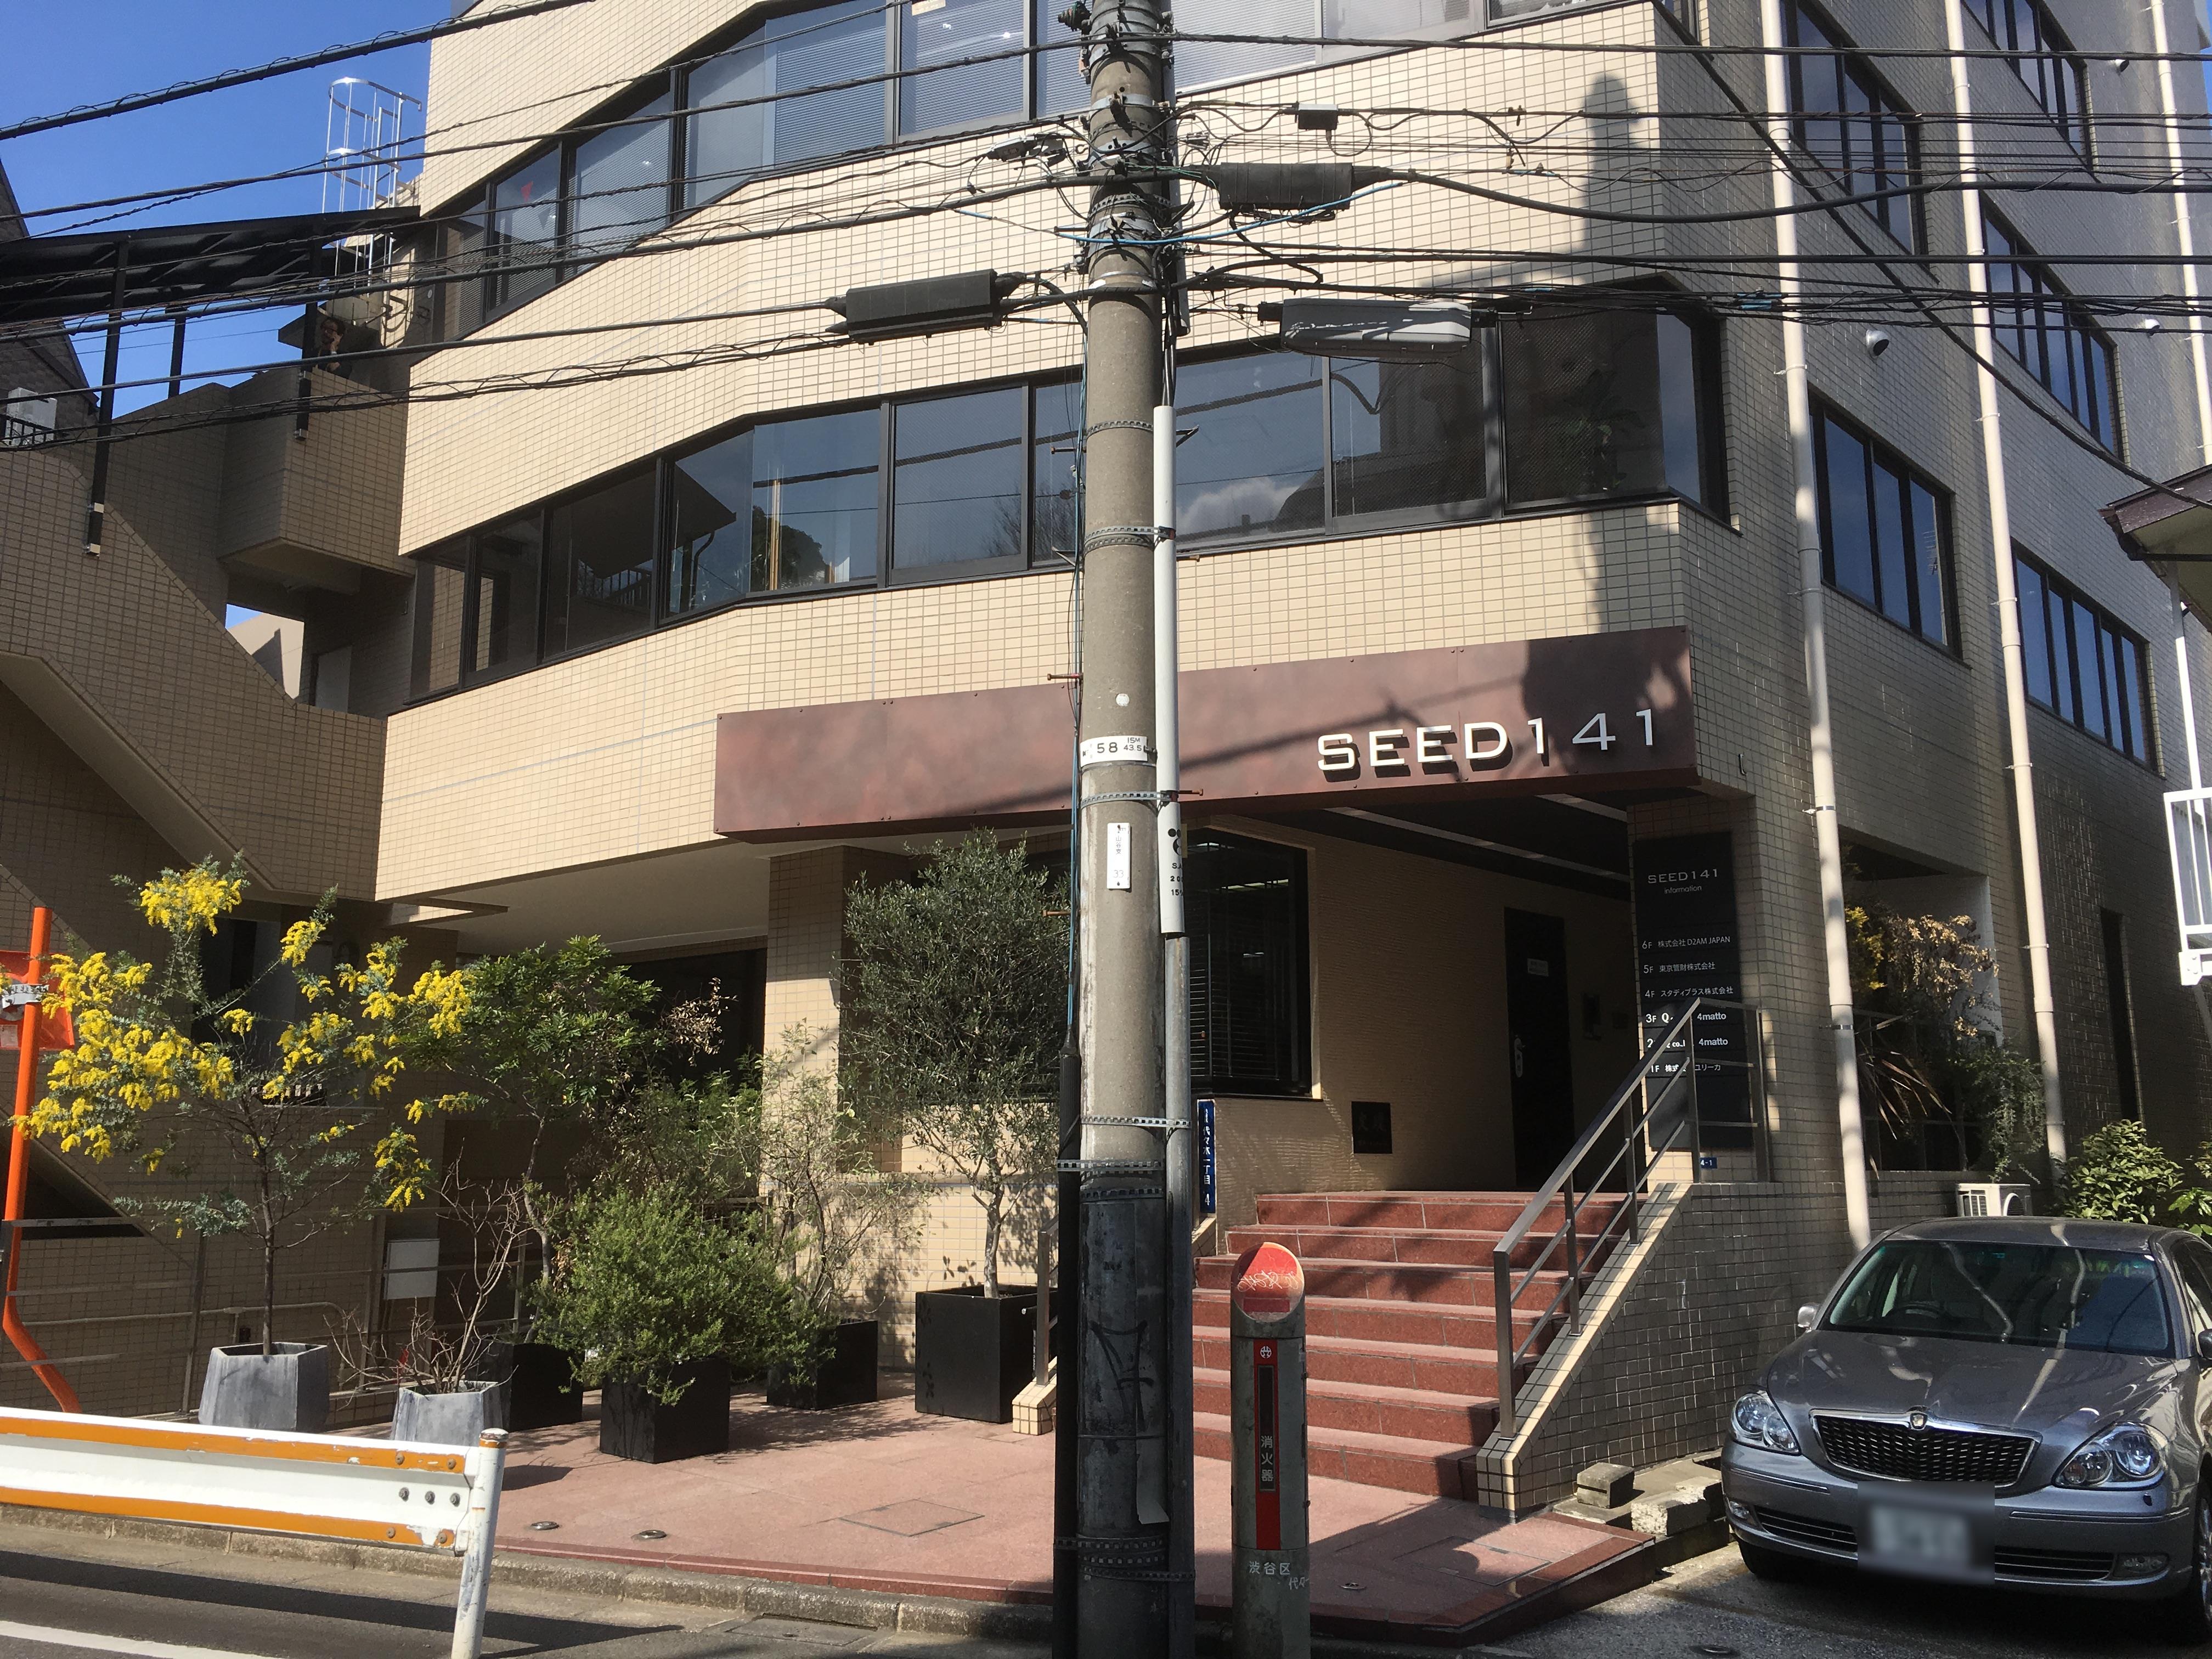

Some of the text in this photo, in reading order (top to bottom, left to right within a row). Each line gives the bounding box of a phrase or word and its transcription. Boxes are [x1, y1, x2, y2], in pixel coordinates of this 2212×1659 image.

[1317, 709, 1653, 771] SEED141
[1097, 742, 1118, 753] 58
[1647, 868, 1718, 884] SEED141
[1664, 885, 1702, 894] information
[1642, 940, 1653, 949] 6F
[1708, 936, 1731, 944] JAPAN
[1643, 964, 1654, 974] 5F
[1645, 990, 1655, 998] 4F
[1646, 1013, 1657, 1023] 3F
[1697, 1012, 1727, 1021] 4matto
[1699, 1037, 1728, 1046] 4matto
[1203, 1126, 1211, 1185] 代々木一丁目
[1204, 1193, 1210, 1206] 4
[1261, 1435, 1274, 1482] 消火器
[1249, 1560, 1290, 1575] 渋谷区
[1288, 1576, 1310, 1590] 代々
